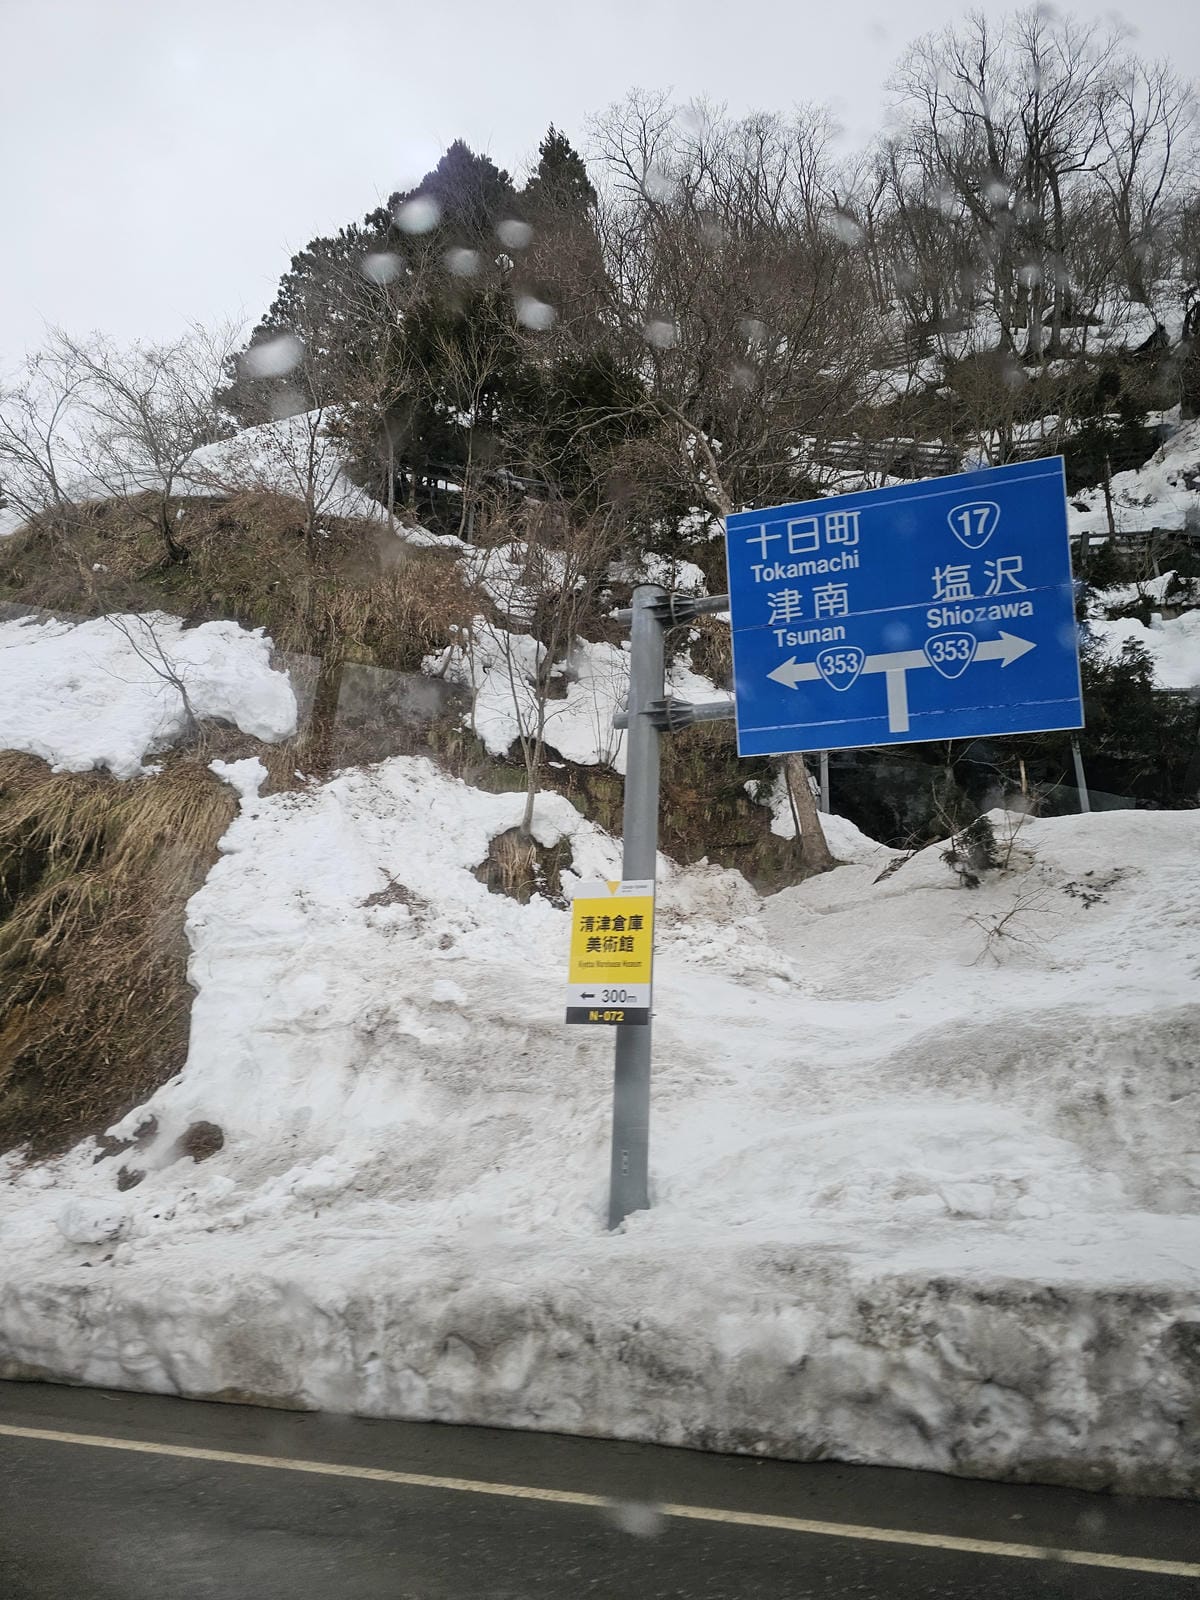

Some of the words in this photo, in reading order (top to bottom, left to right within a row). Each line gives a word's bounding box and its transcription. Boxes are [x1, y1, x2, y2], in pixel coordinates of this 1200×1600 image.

[746, 511, 861, 560] 十日町
[957, 508, 989, 536] 17
[751, 550, 860, 582] Tokamachi
[932, 556, 1026, 601] 塩沢
[767, 582, 849, 625] 津南
[927, 600, 1034, 628] Shiozawa
[774, 625, 846, 648] Tsunan
[823, 653, 858, 676] 353
[933, 639, 969, 663] 353
[580, 914, 644, 932] 清津倉庫
[586, 936, 634, 952] 美術館
